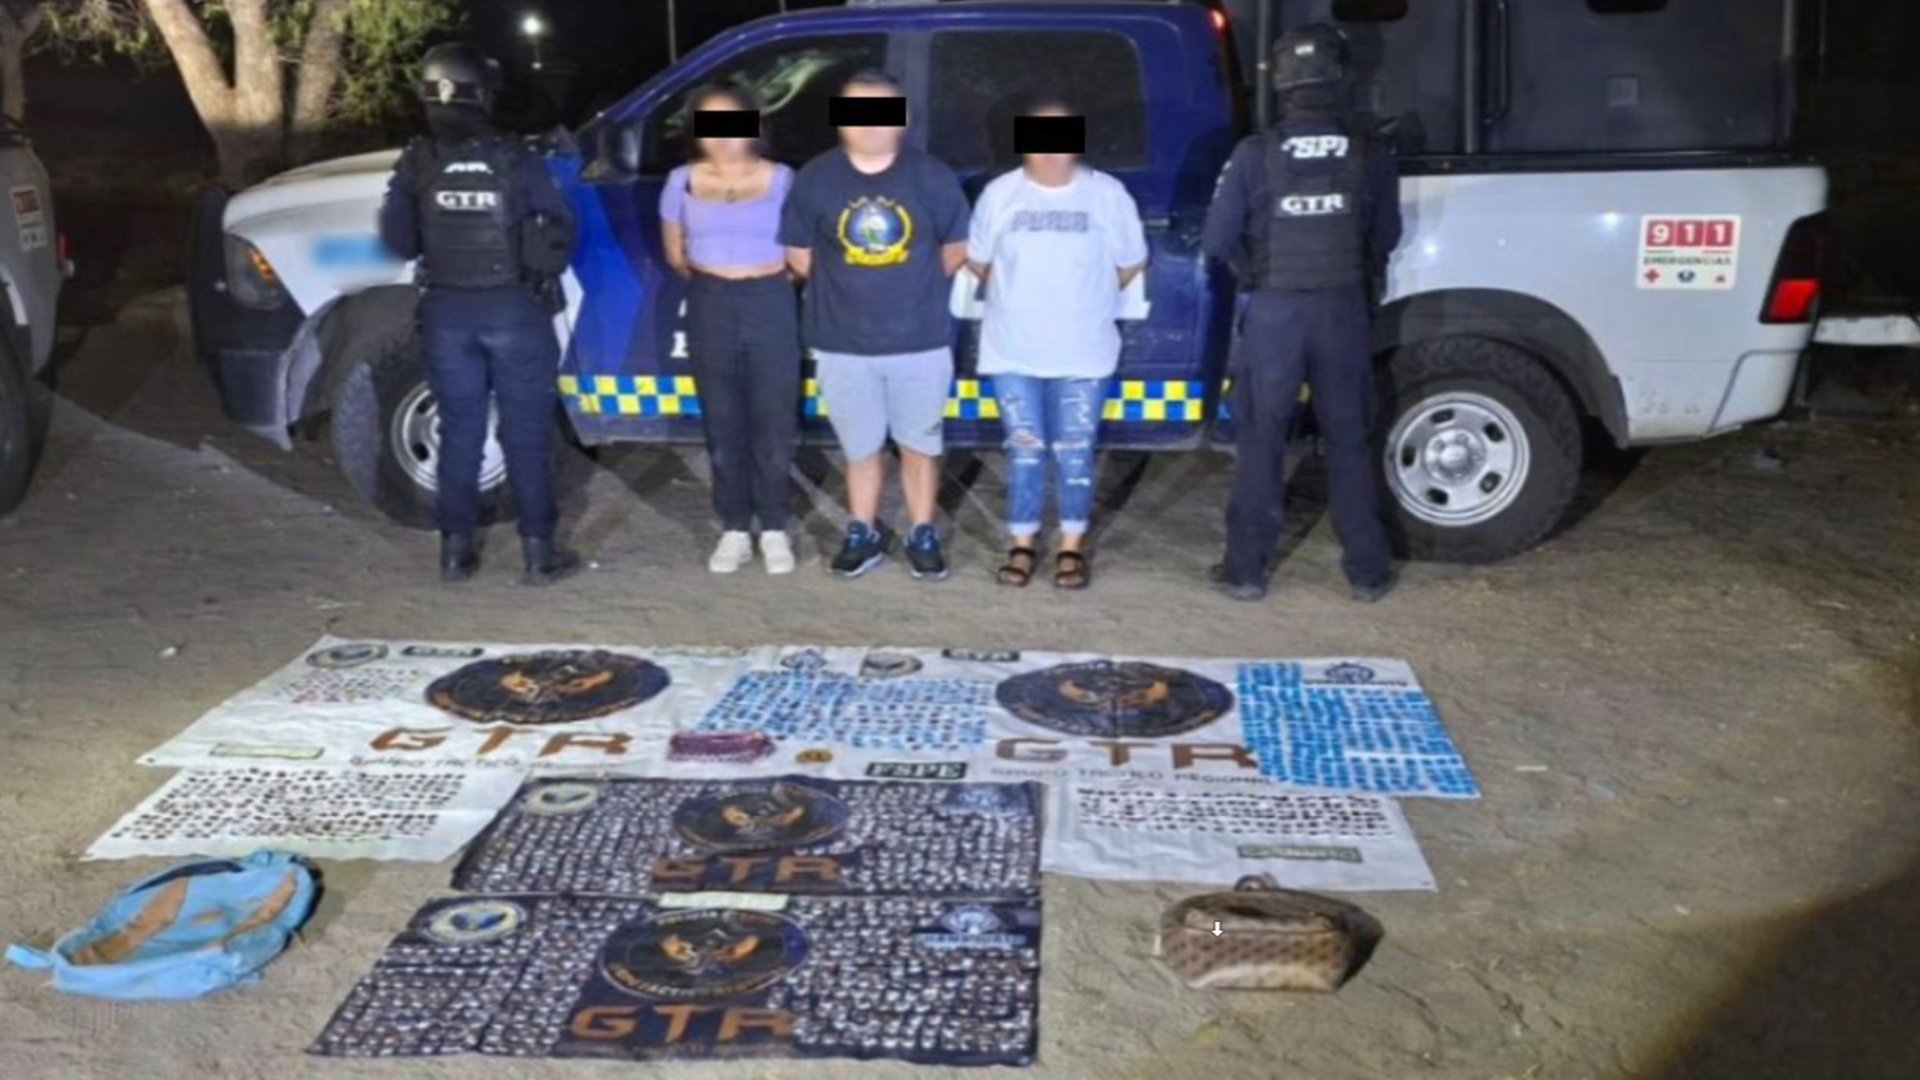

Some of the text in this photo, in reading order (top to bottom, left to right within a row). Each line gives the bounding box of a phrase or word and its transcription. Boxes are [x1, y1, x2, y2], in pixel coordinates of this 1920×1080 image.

[436, 190, 497, 210] GTR
[1281, 193, 1344, 215] GTR
[1652, 223, 1725, 243] 911
[369, 726, 633, 758] GTR
[995, 738, 1258, 770] GTR
[651, 856, 842, 884] GTR
[572, 1002, 797, 1044] GTR
